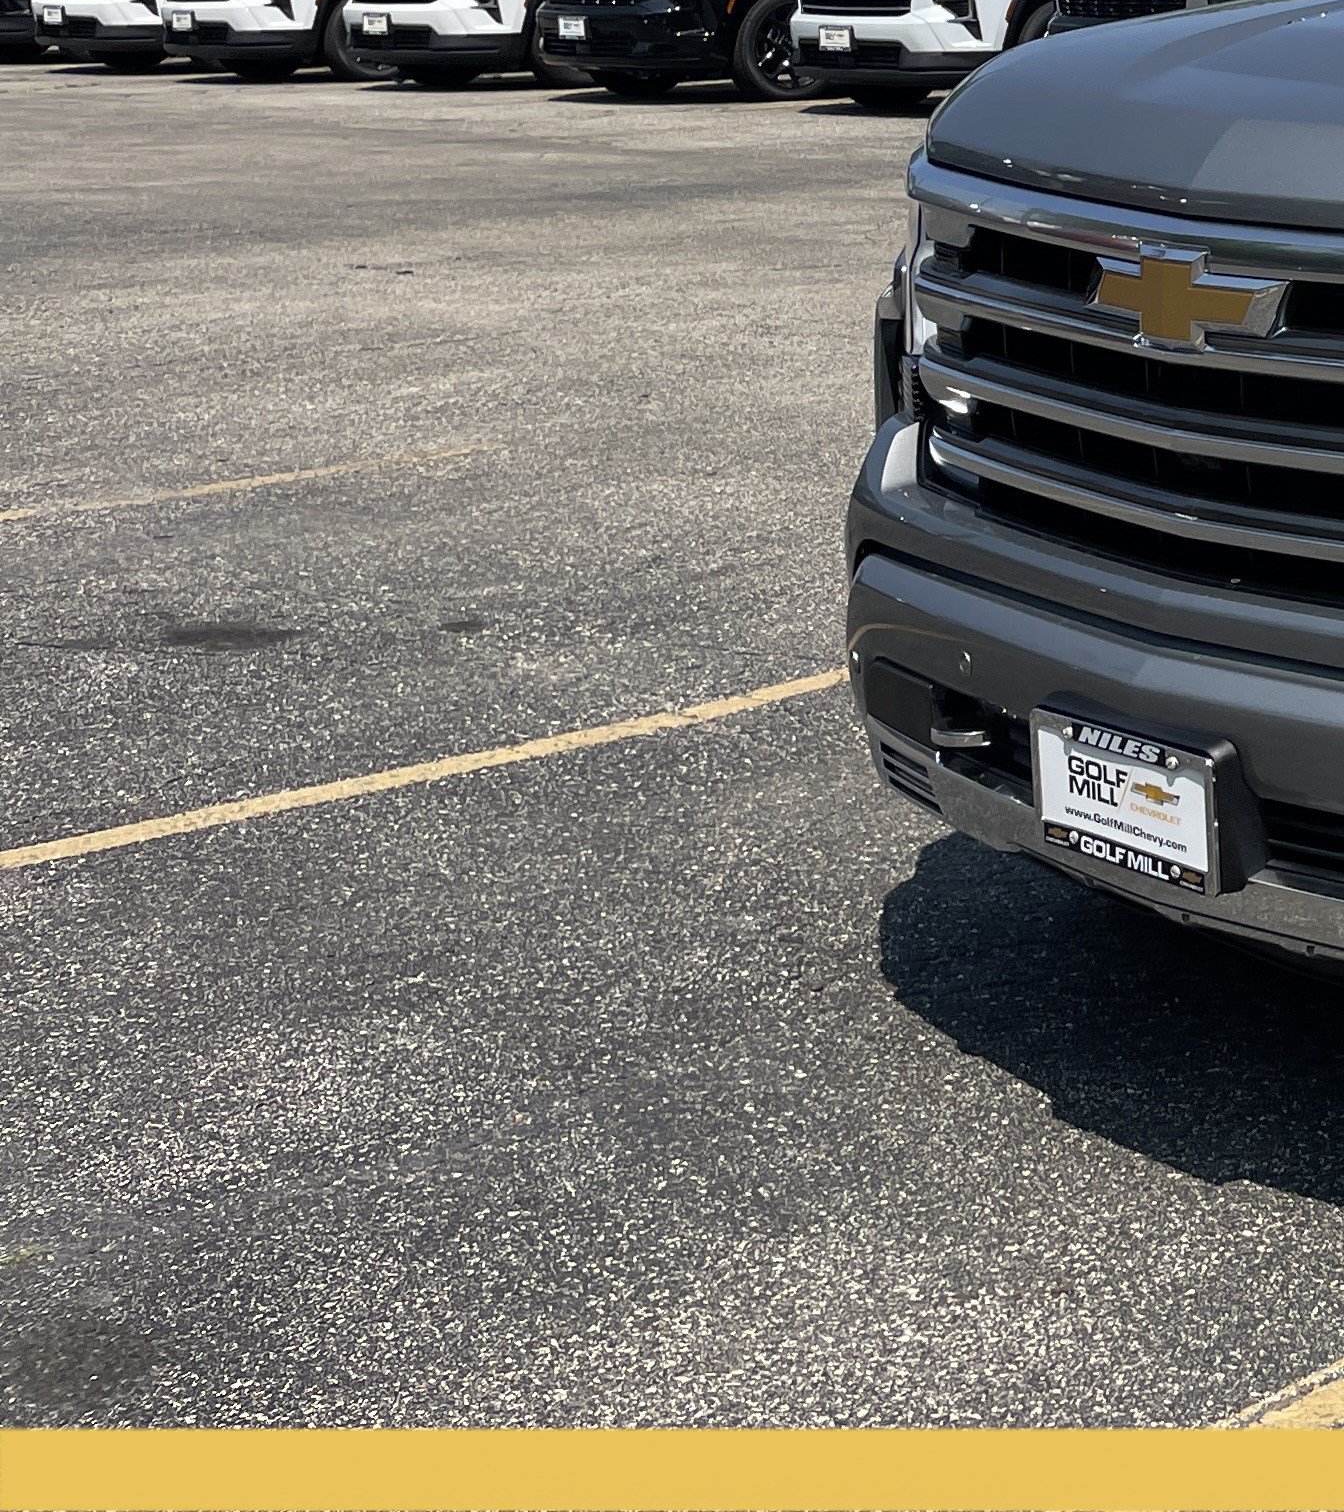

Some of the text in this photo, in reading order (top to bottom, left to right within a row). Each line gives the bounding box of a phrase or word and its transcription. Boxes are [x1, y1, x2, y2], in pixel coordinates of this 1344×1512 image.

[1077, 725, 1162, 764] NILES
[1067, 754, 1129, 788] GOLF
[1068, 775, 1119, 807] MILL
[1064, 804, 1188, 853] www.GolfMillChevy.com
[1129, 802, 1182, 826] CHEVROLET
[1080, 835, 1170, 881] GOLF MILL
